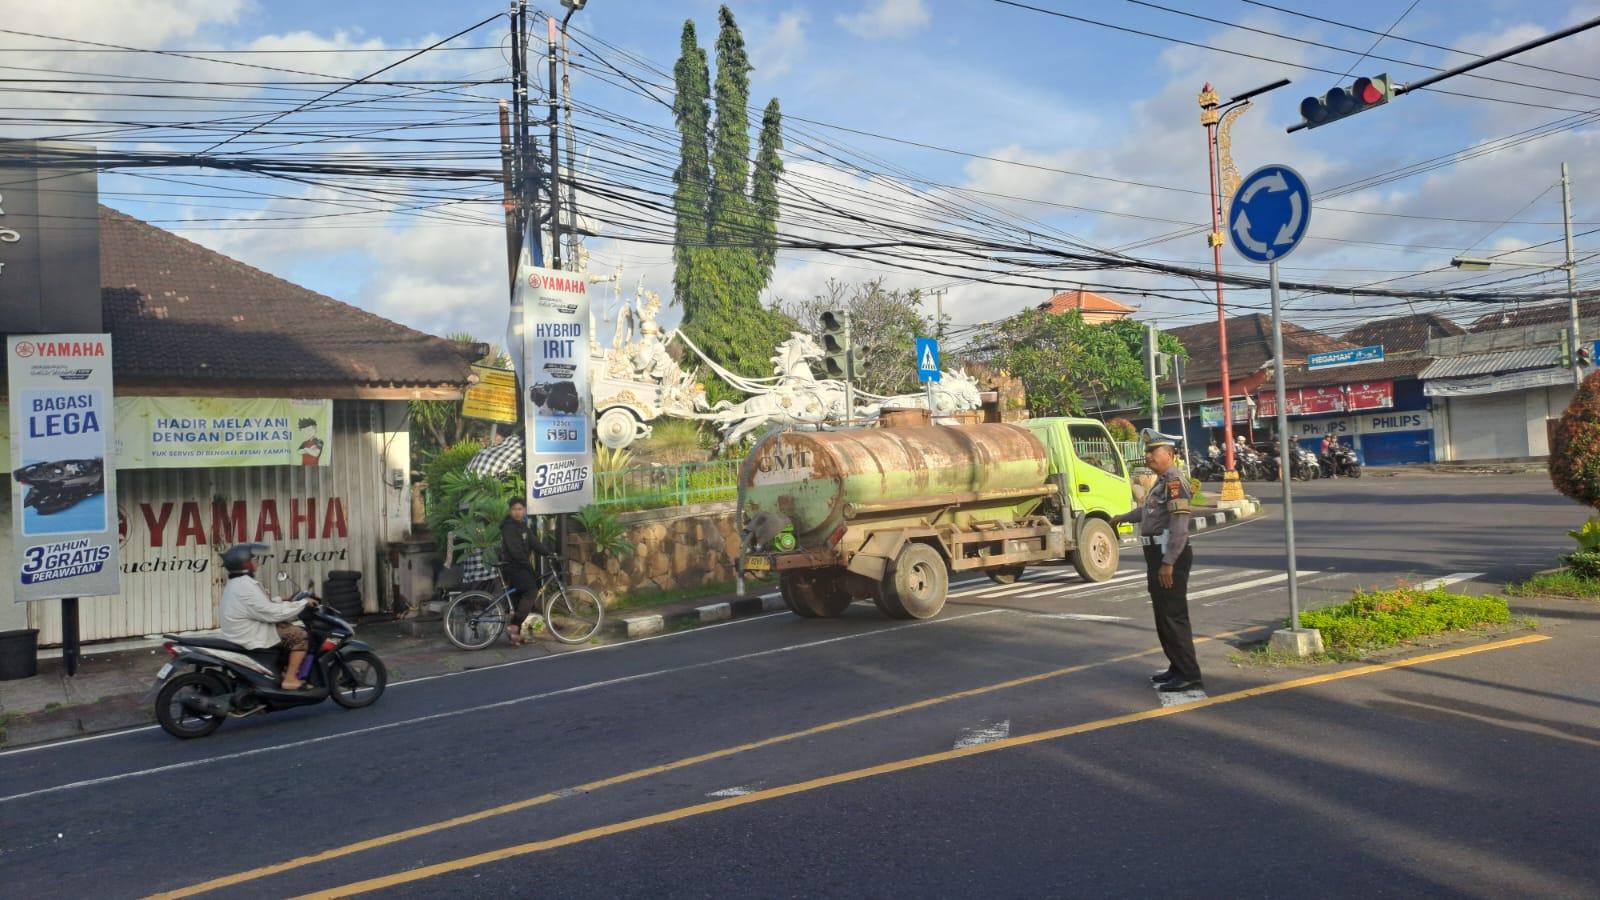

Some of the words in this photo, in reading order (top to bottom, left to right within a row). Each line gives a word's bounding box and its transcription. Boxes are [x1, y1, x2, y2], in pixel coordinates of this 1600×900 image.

[542, 275, 586, 294] YAMAHA
[536, 323, 582, 337] HYBRID
[36, 342, 105, 357] YAMAHA
[543, 340, 575, 359] IRIT
[33, 394, 93, 412] BAGASI
[29, 411, 100, 438] LEGA
[157, 418, 208, 429] HADIR
[212, 418, 289, 429] MELAYANI
[1372, 414, 1421, 429] PHILIPS
[152, 431, 220, 443] DENGAN
[225, 430, 293, 442] DEDIKASI
[263, 448, 291, 456] YAMAH
[534, 464, 548, 488] 3
[549, 460, 575, 471] TAHUN
[548, 466, 588, 485] GRATIS
[140, 497, 348, 547] YAMAHA
[23, 546, 45, 572] 3
[47, 539, 89, 553] TAHUN
[45, 545, 110, 570] GRATIS
[119, 556, 208, 574] uching
[281, 548, 349, 564] Heart
